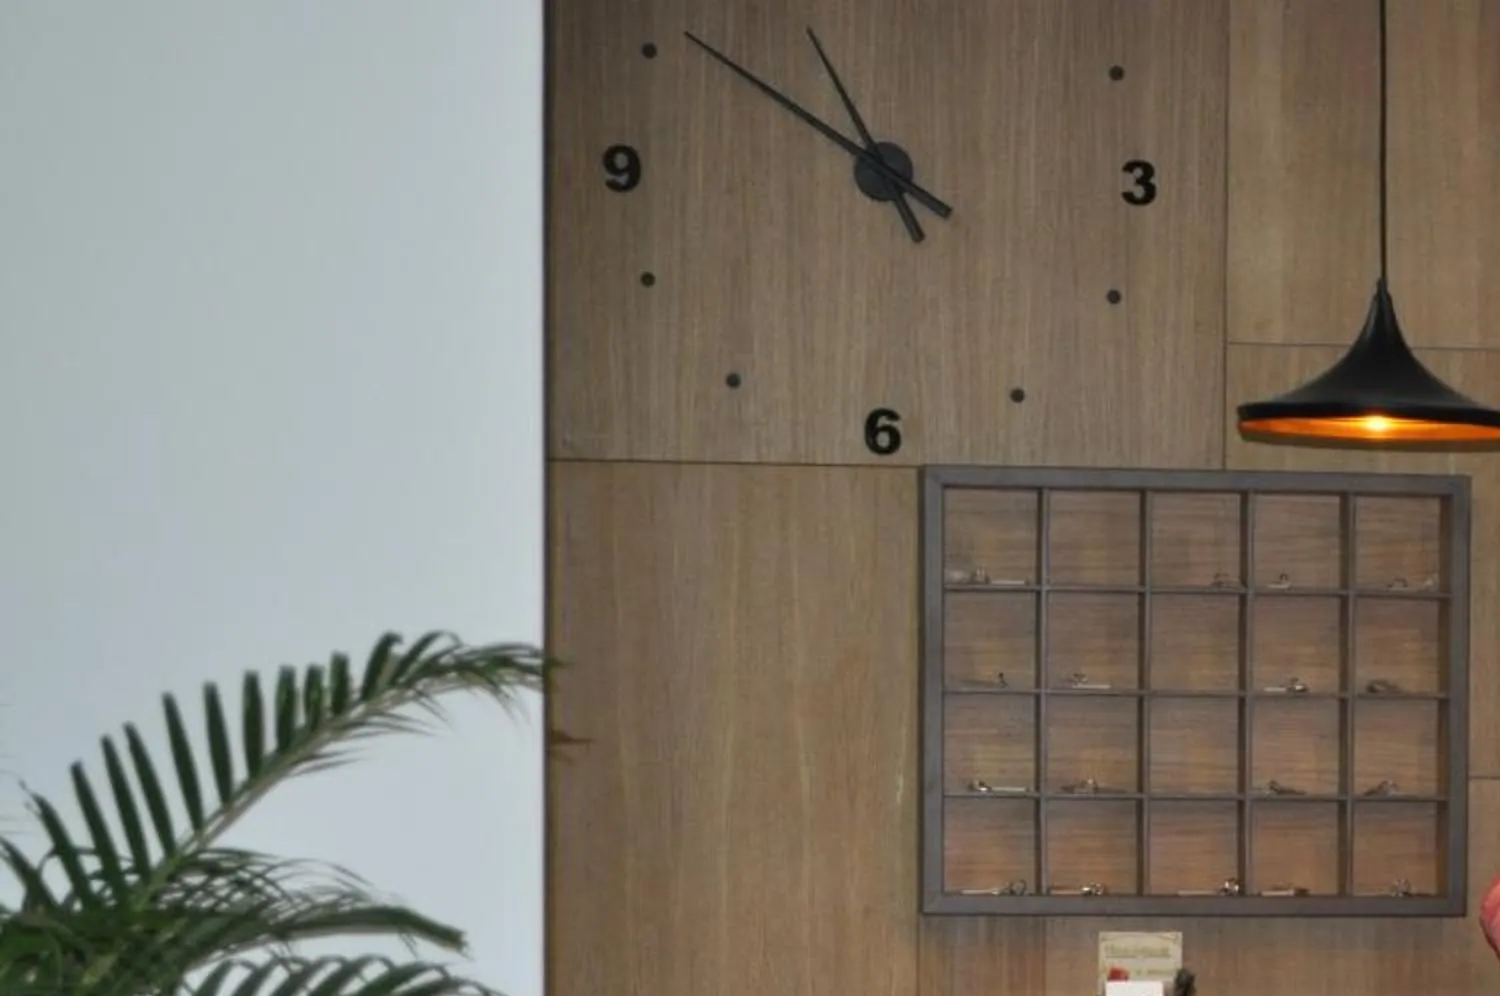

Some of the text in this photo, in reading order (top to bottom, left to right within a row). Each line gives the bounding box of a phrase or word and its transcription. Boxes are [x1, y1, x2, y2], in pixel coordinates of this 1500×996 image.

[602, 144, 642, 192] 9
[1121, 159, 1157, 206] 3
[864, 408, 901, 455] 6
